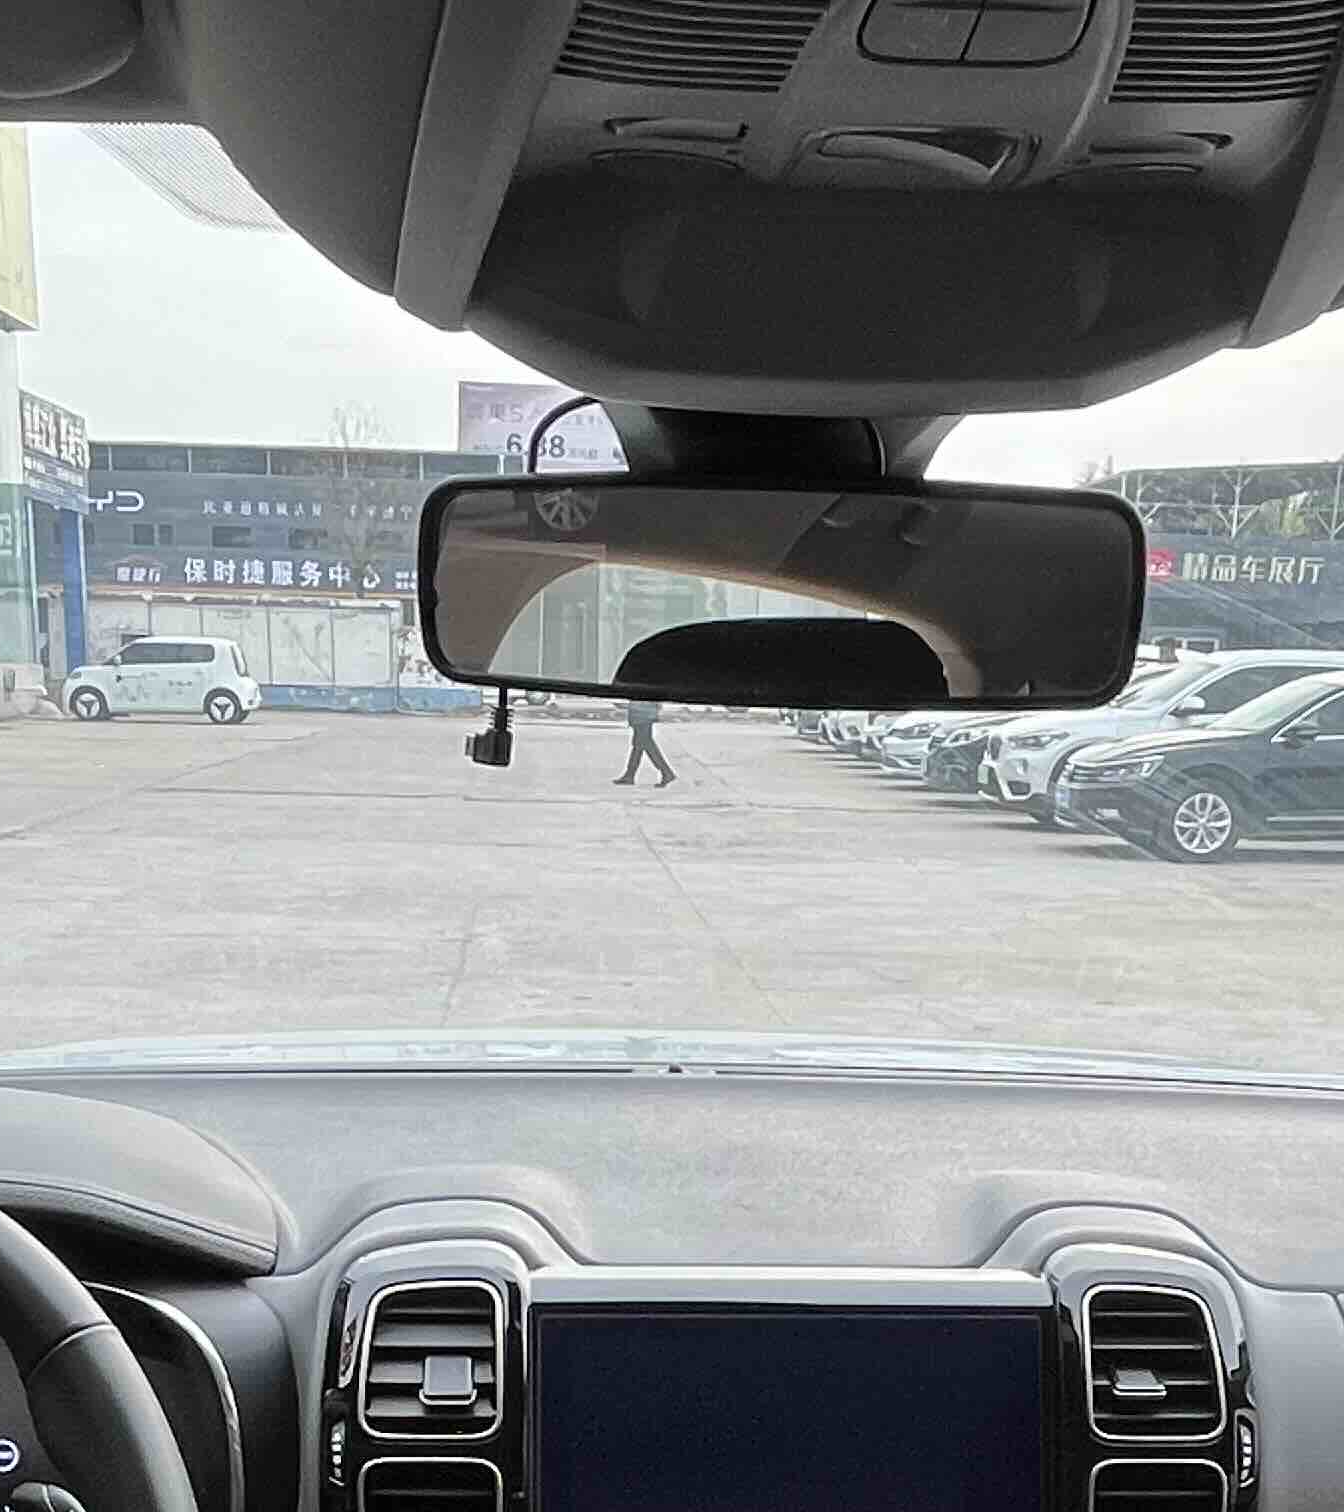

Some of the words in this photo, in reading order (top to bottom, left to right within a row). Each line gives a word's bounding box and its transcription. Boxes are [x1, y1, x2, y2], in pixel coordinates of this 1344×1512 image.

[184, 556, 381, 590] 保时捷服务中心
[1182, 551, 1327, 585] 精品车展厅
